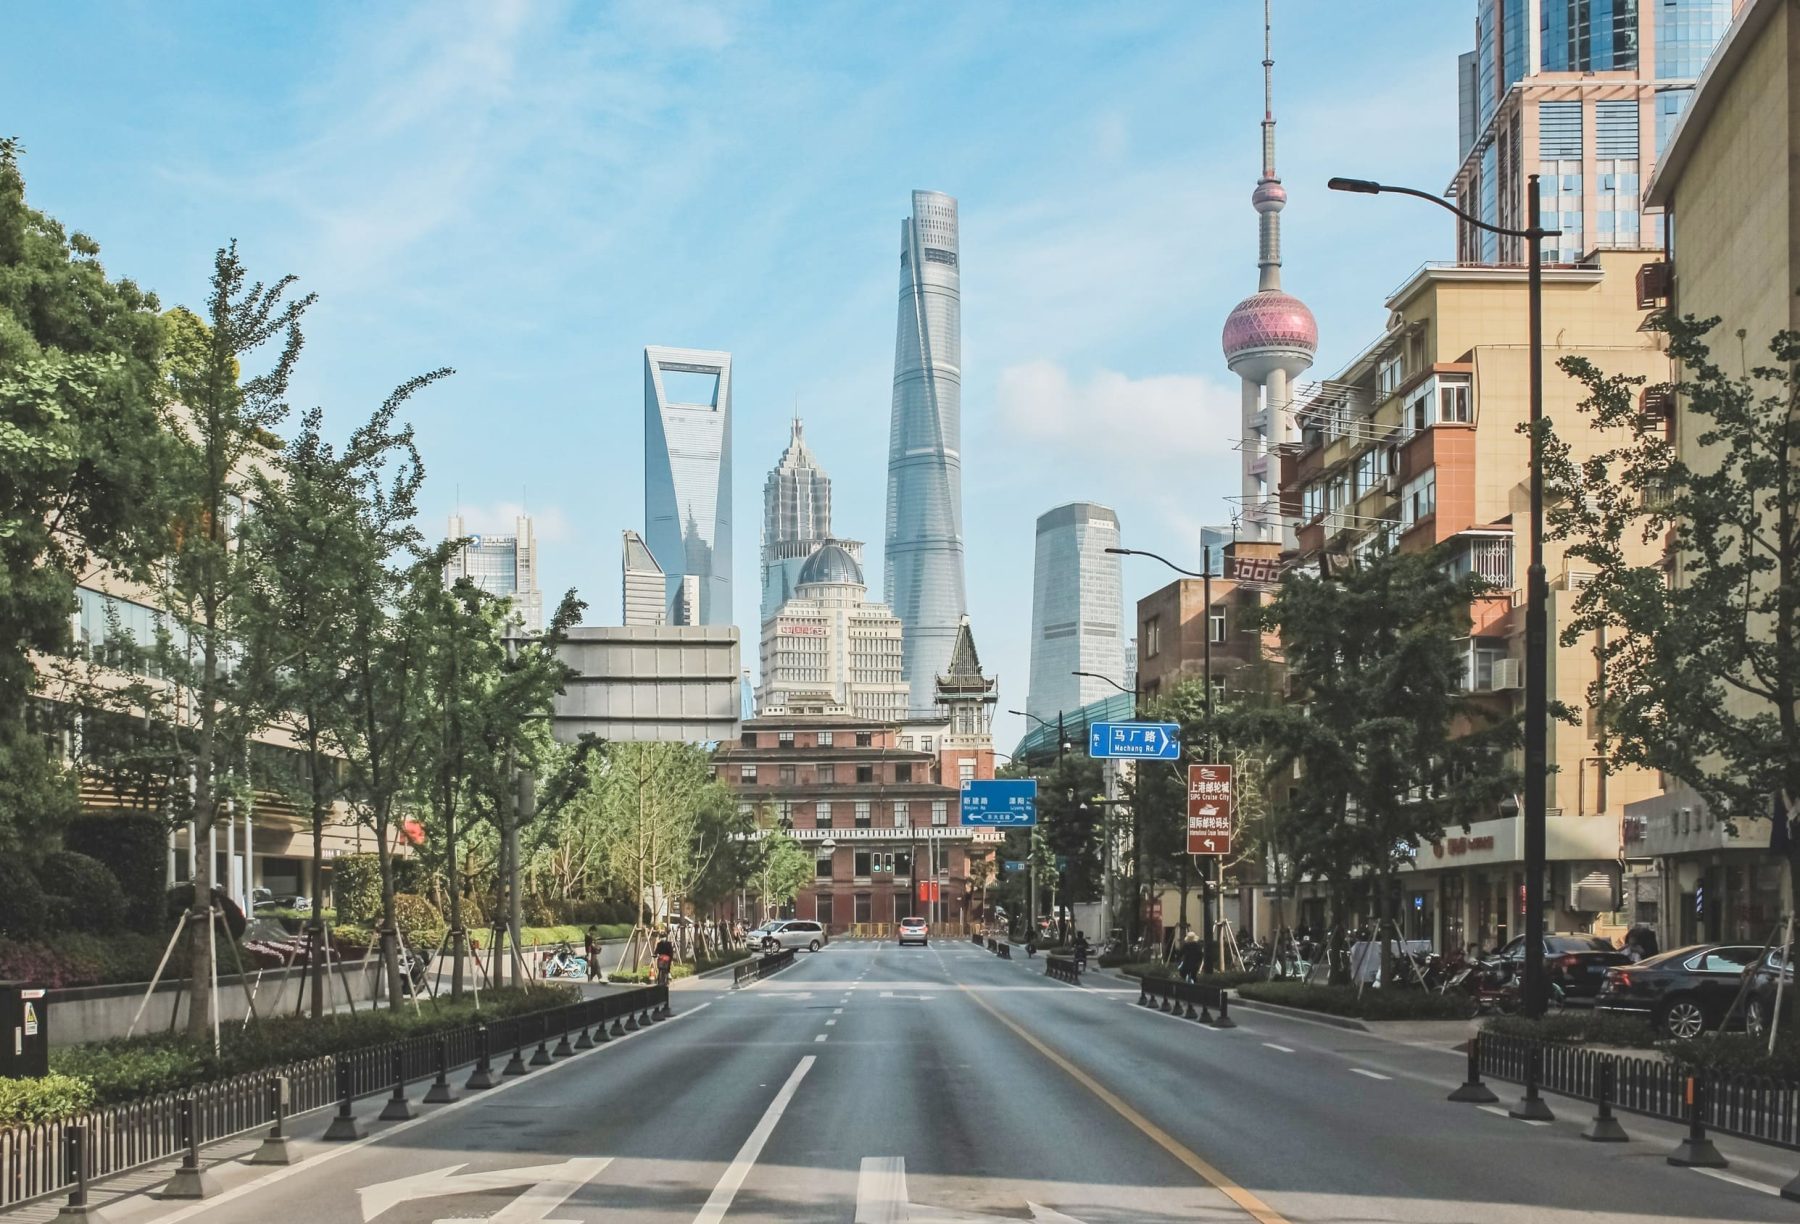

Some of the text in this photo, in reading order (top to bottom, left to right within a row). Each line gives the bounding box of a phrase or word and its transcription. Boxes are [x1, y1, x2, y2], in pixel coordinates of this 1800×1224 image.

[1114, 729, 1156, 743] 马厂路
[1190, 781, 1229, 793] 上港邮轮城
[1219, 793, 1229, 802] City
[1190, 816, 1229, 829] 国际邮轮码头
